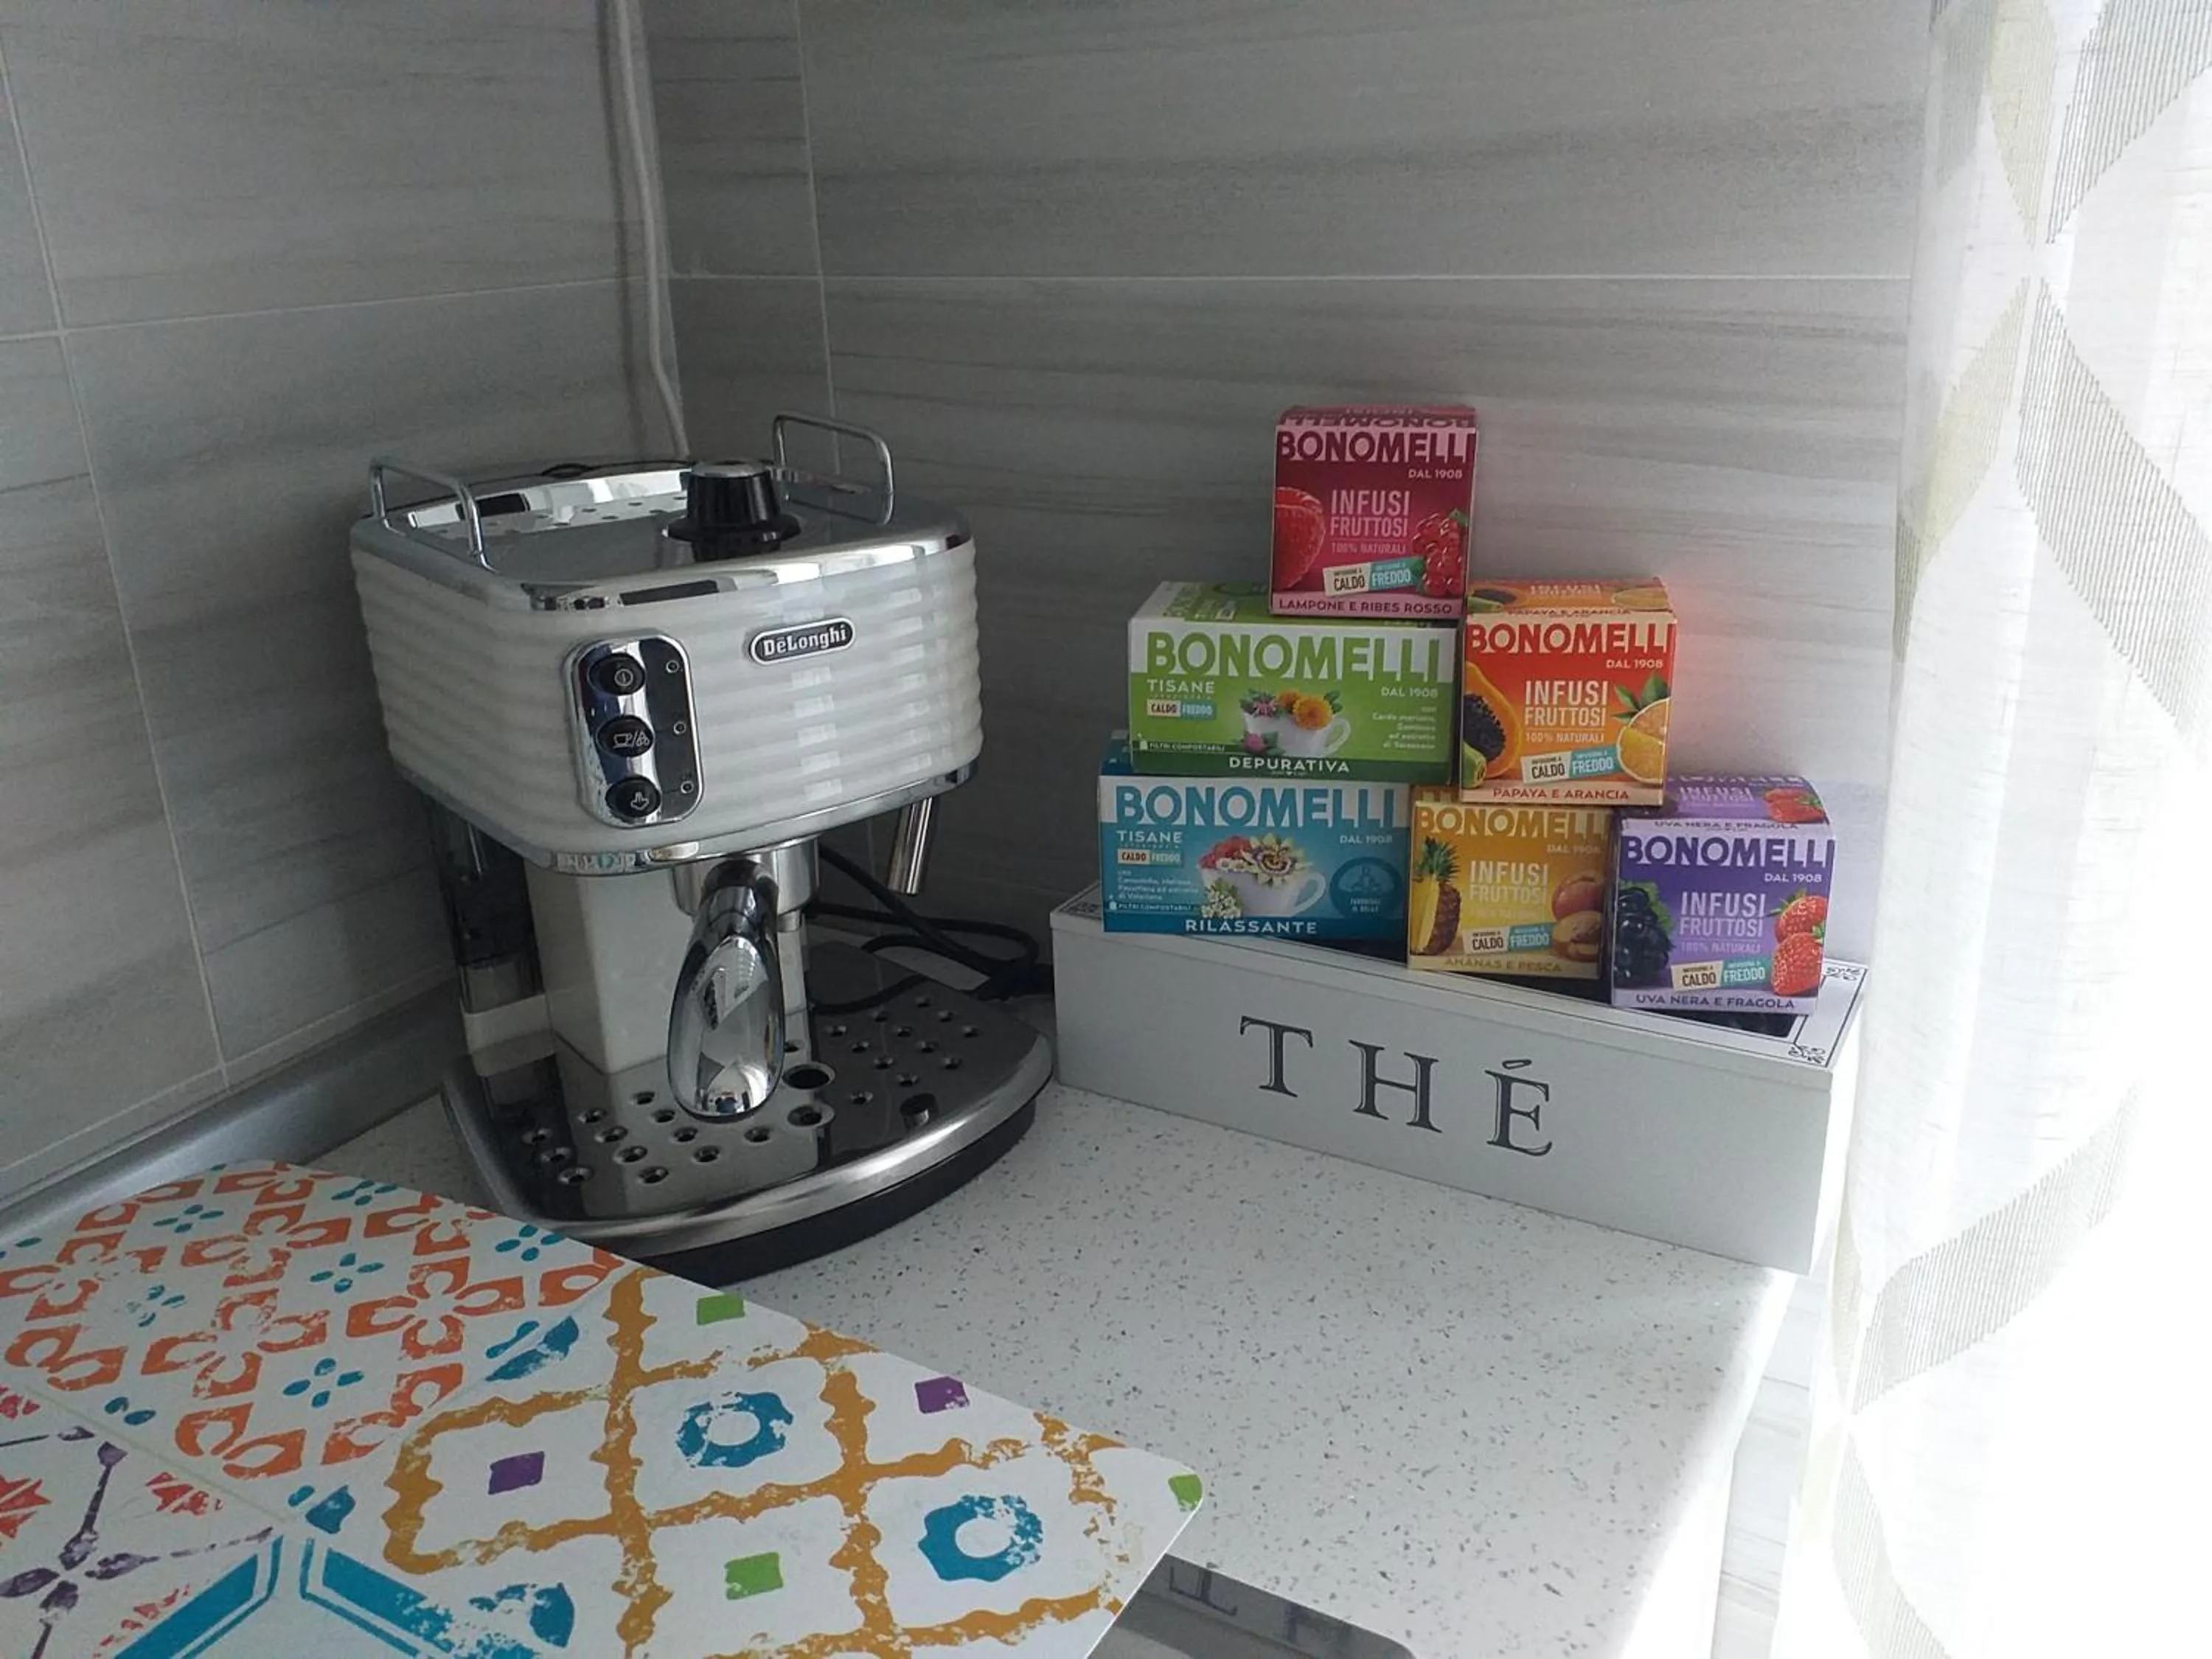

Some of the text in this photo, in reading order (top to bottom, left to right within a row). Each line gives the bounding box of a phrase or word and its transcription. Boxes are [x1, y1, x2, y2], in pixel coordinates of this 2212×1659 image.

[1277, 431, 1477, 463] BONOMELLI
[1408, 468, 1463, 479] DAL 1908
[1331, 489, 1411, 515] INFUSI
[1329, 515, 1408, 538] FRUTTOSI
[1333, 574, 1366, 591] CALDO
[1371, 568, 1411, 588] FREDDO
[1279, 599, 1453, 614] LAMPONE E RIBES ROSSO
[1467, 623, 1677, 655] BONOMELLI
[1147, 632, 1441, 682] BONOMELLI
[1606, 658, 1664, 669] DAL 1908
[1147, 678, 1216, 694] TISANE
[1381, 686, 1438, 698] DAL 1908
[1525, 680, 1609, 706] INFUSI
[1150, 703, 1178, 714] CALDO
[1524, 706, 1607, 727] FRUTTOSI
[1229, 756, 1350, 774] DEPURATIVA
[1531, 763, 1566, 779] CALDO
[1571, 756, 1614, 775] FREDDO
[1493, 788, 1630, 800] PAPAYA E ARANCIA
[1116, 785, 1395, 828] BONOMELLI
[1415, 806, 1613, 838] BONOMELLI
[1116, 830, 1183, 844] TISANE
[1340, 834, 1364, 845] DAL
[1121, 852, 1147, 861] CALDO
[1621, 835, 1836, 868] BONOMELLI
[1470, 860, 1548, 886] INFUSI
[1764, 873, 1823, 883] DAL 1908
[1470, 884, 1548, 905] FRUTTOSI
[1680, 891, 1767, 918] INFUSI
[1185, 919, 1318, 934] RILASSANTE
[1679, 917, 1764, 938] FRUTTOSI
[1472, 936, 1504, 950] CALDO
[1510, 933, 1550, 948] FREDDO
[1682, 972, 1717, 987] CALDO
[1722, 967, 1766, 983] FREDDO
[1635, 994, 1795, 1009] UVA NERA E FRAGOLA
[1240, 1015, 1553, 1156] THÉ
